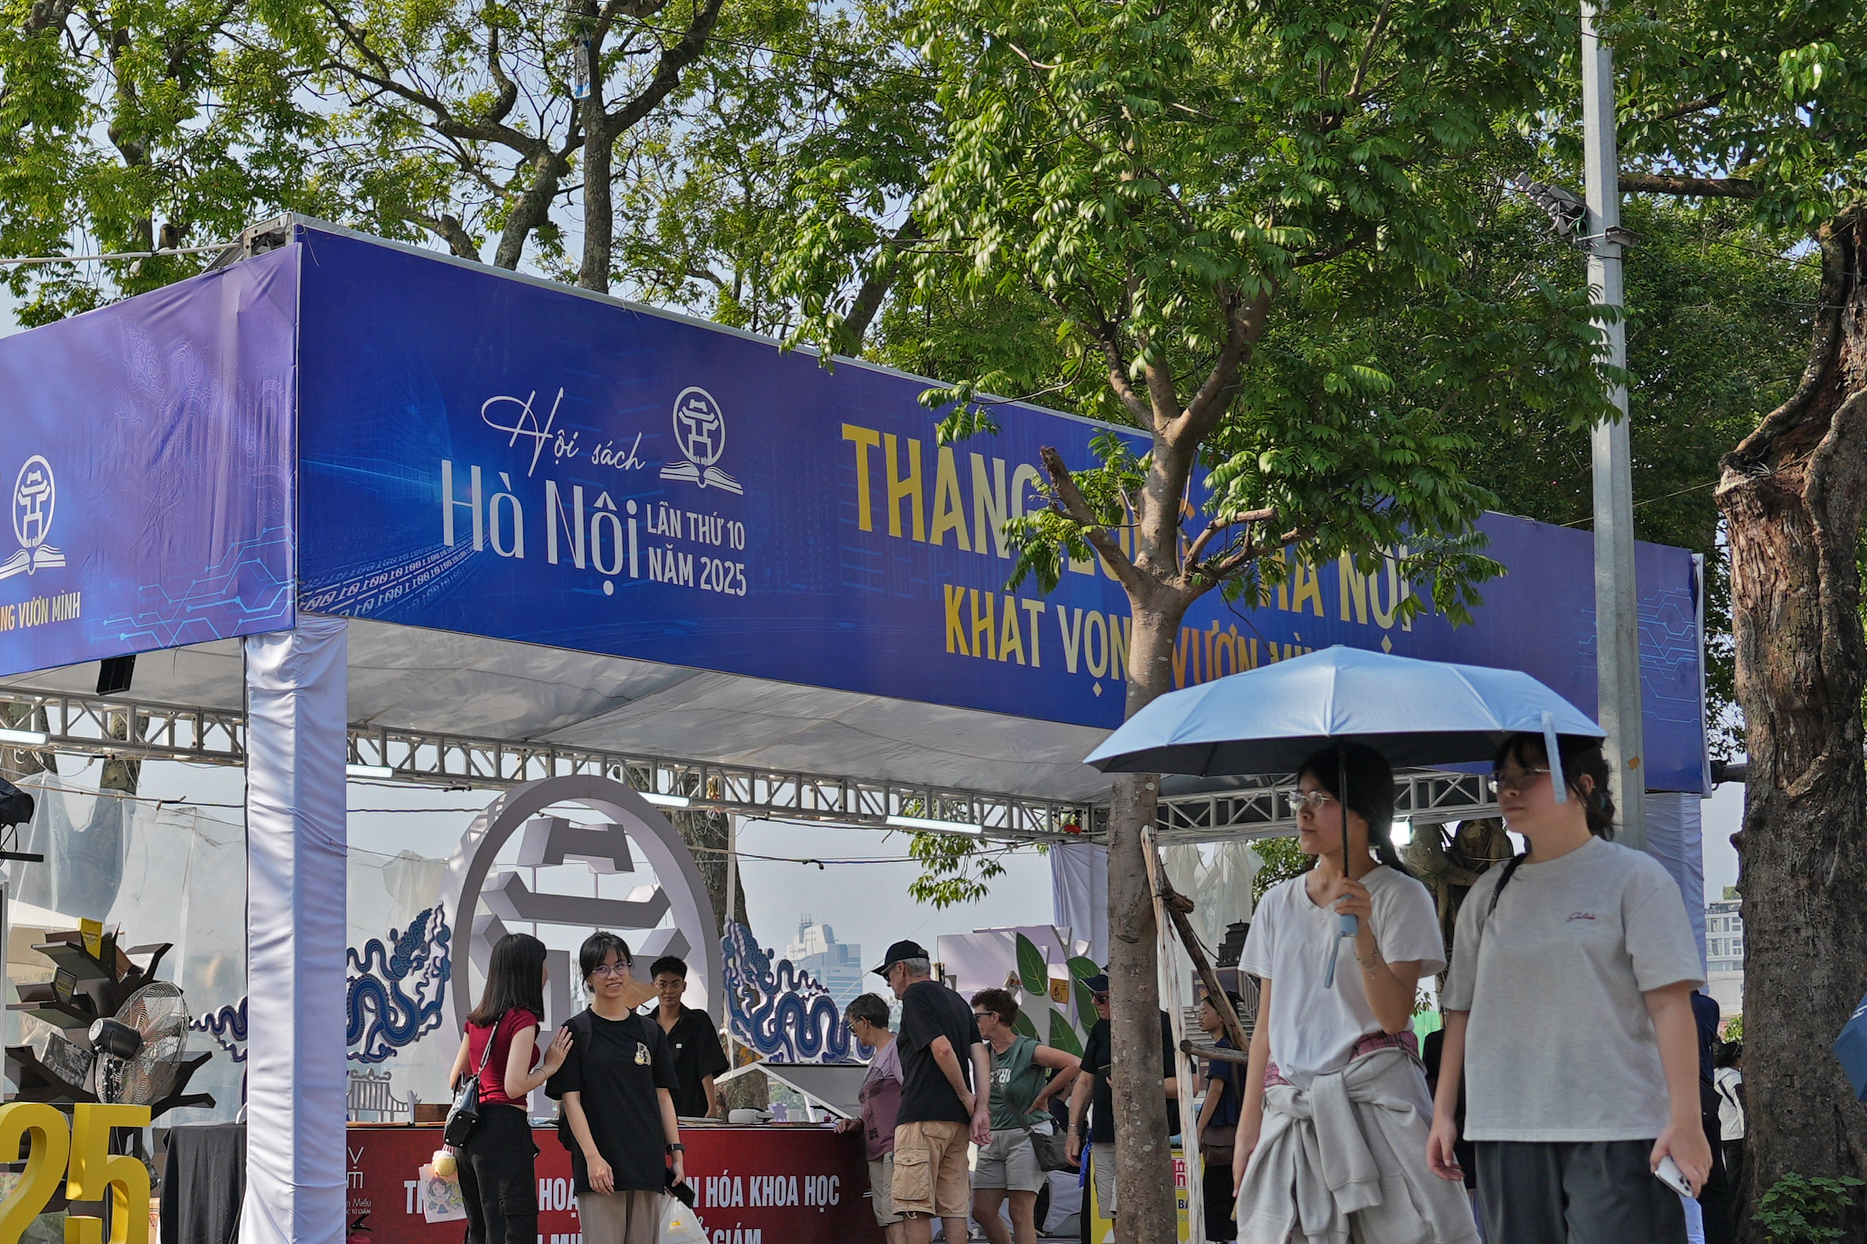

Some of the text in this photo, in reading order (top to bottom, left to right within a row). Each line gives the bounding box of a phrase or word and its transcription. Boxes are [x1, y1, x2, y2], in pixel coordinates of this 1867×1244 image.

[480, 386, 647, 478] Hội sách
[441, 459, 525, 560] Hà
[546, 479, 639, 596] Nội
[646, 501, 745, 551] LẦN THỨ 10
[648, 541, 747, 597] NĂM 2025
[18, 596, 49, 629] VƯƠN
[52, 589, 81, 622] MÌNH
[1056, 604, 1132, 697] VỌN
[538, 1178, 579, 1218] HOẠ
[706, 1169, 744, 1208] HÓA
[750, 1175, 799, 1207] KHOA
[804, 1174, 840, 1213] HỌC
